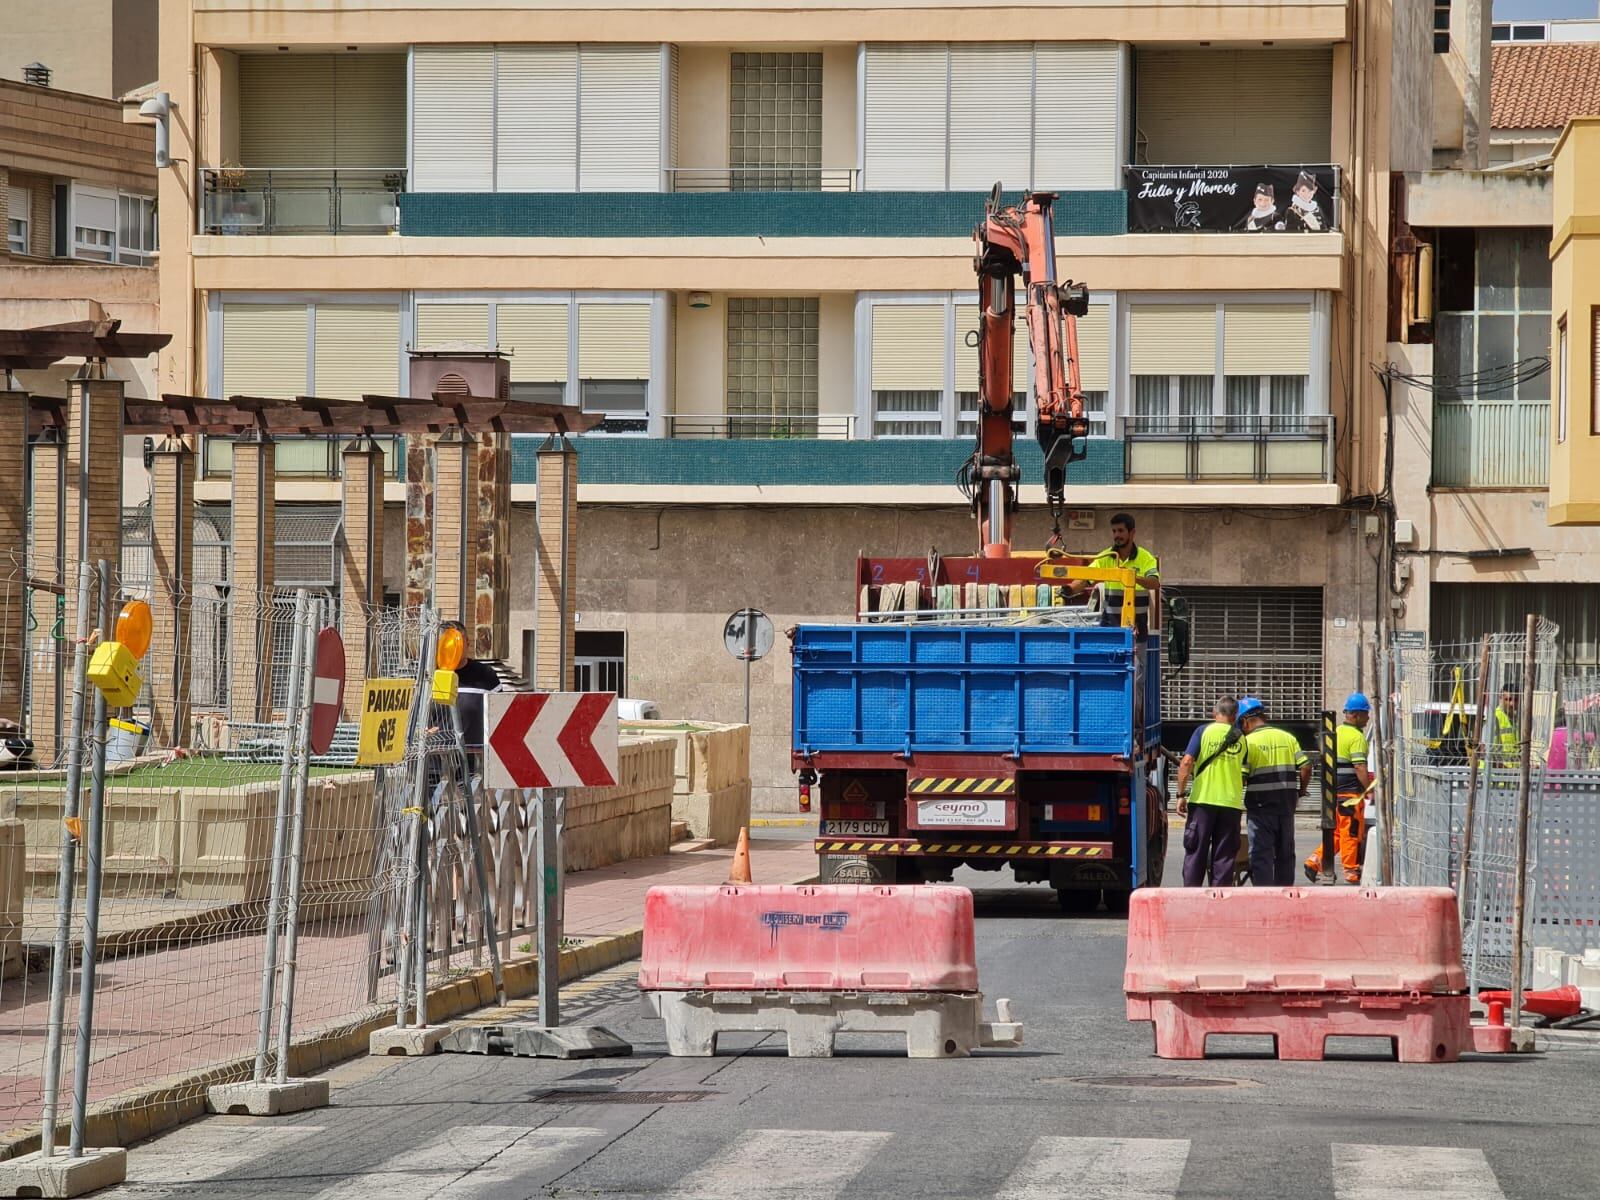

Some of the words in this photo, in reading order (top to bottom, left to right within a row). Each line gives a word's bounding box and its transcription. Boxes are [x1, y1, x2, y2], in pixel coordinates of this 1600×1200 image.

[1180, 170, 1206, 179] Infantil
[1207, 170, 1229, 179] 2020
[1174, 187, 1187, 202] y
[1188, 179, 1238, 197] Marcos
[873, 564, 885, 582] 2
[916, 567, 925, 582] 3
[965, 563, 980, 582] 4
[828, 821, 859, 833] 2179
[863, 821, 886, 833] CDY
[805, 915, 821, 924] RENT
